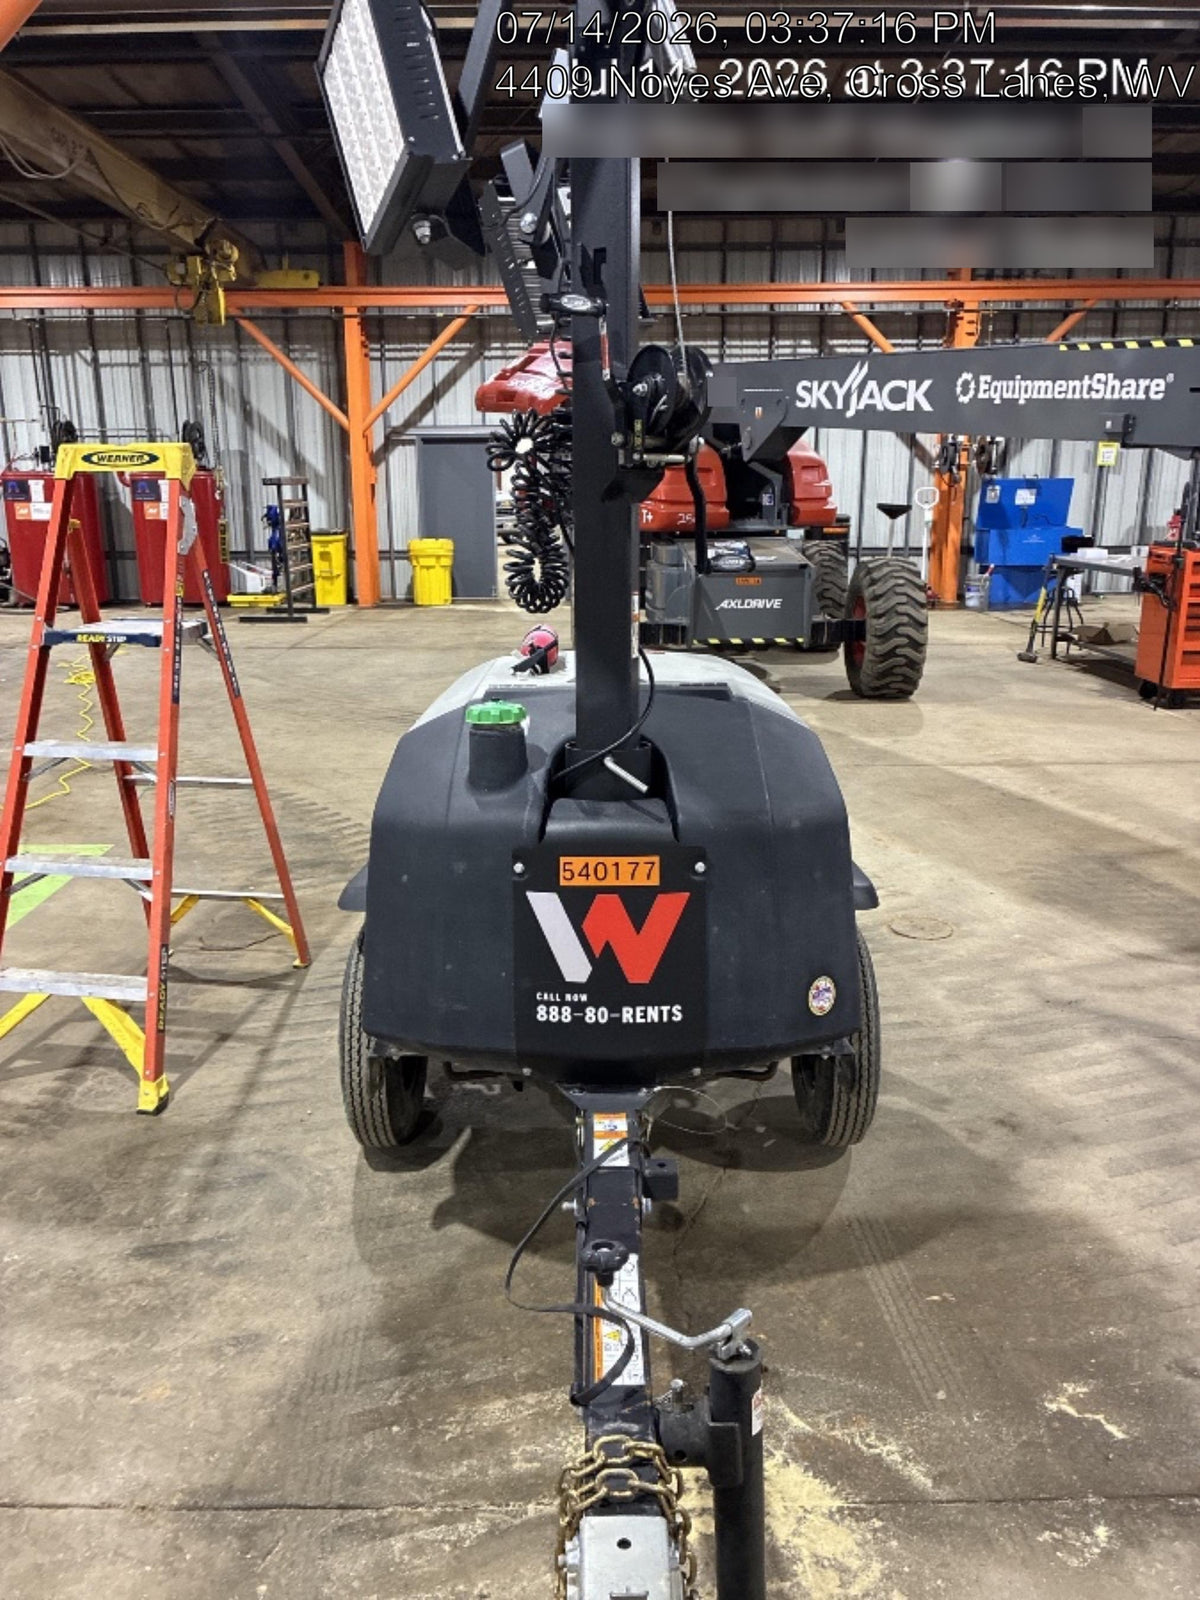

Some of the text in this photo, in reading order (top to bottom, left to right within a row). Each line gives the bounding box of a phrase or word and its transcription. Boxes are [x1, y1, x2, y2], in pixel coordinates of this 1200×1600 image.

[794, 360, 935, 419] SKYJACK
[96, 453, 145, 463] WERNER
[714, 598, 784, 611] AXLDRIVE
[562, 861, 657, 882] 540177
[535, 991, 588, 1003] CALL NOW
[535, 1003, 684, 1024] 888-80-RENTS
